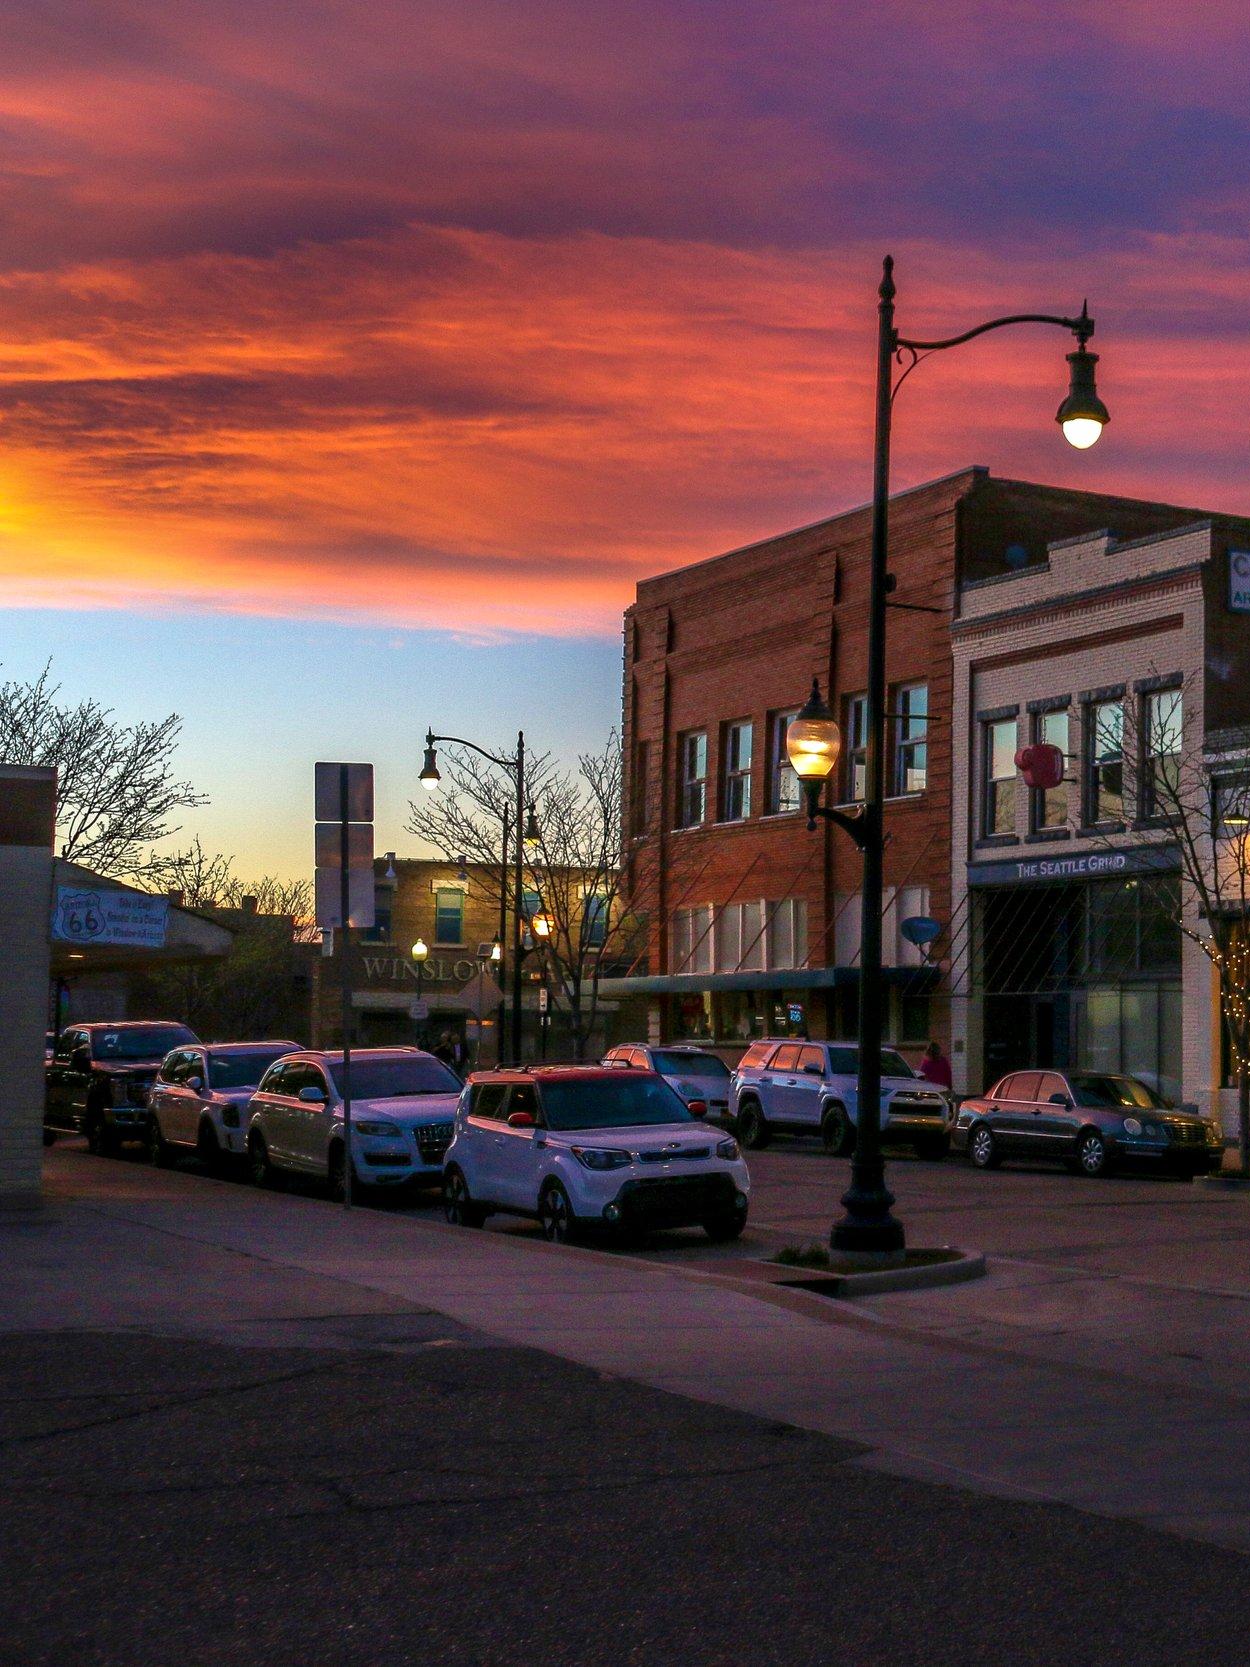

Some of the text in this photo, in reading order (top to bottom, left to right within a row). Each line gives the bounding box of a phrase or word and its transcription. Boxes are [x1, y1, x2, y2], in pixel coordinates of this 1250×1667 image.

[1016, 855, 1126, 878] THE SEATTLE GRIND
[69, 910, 98, 934] 66
